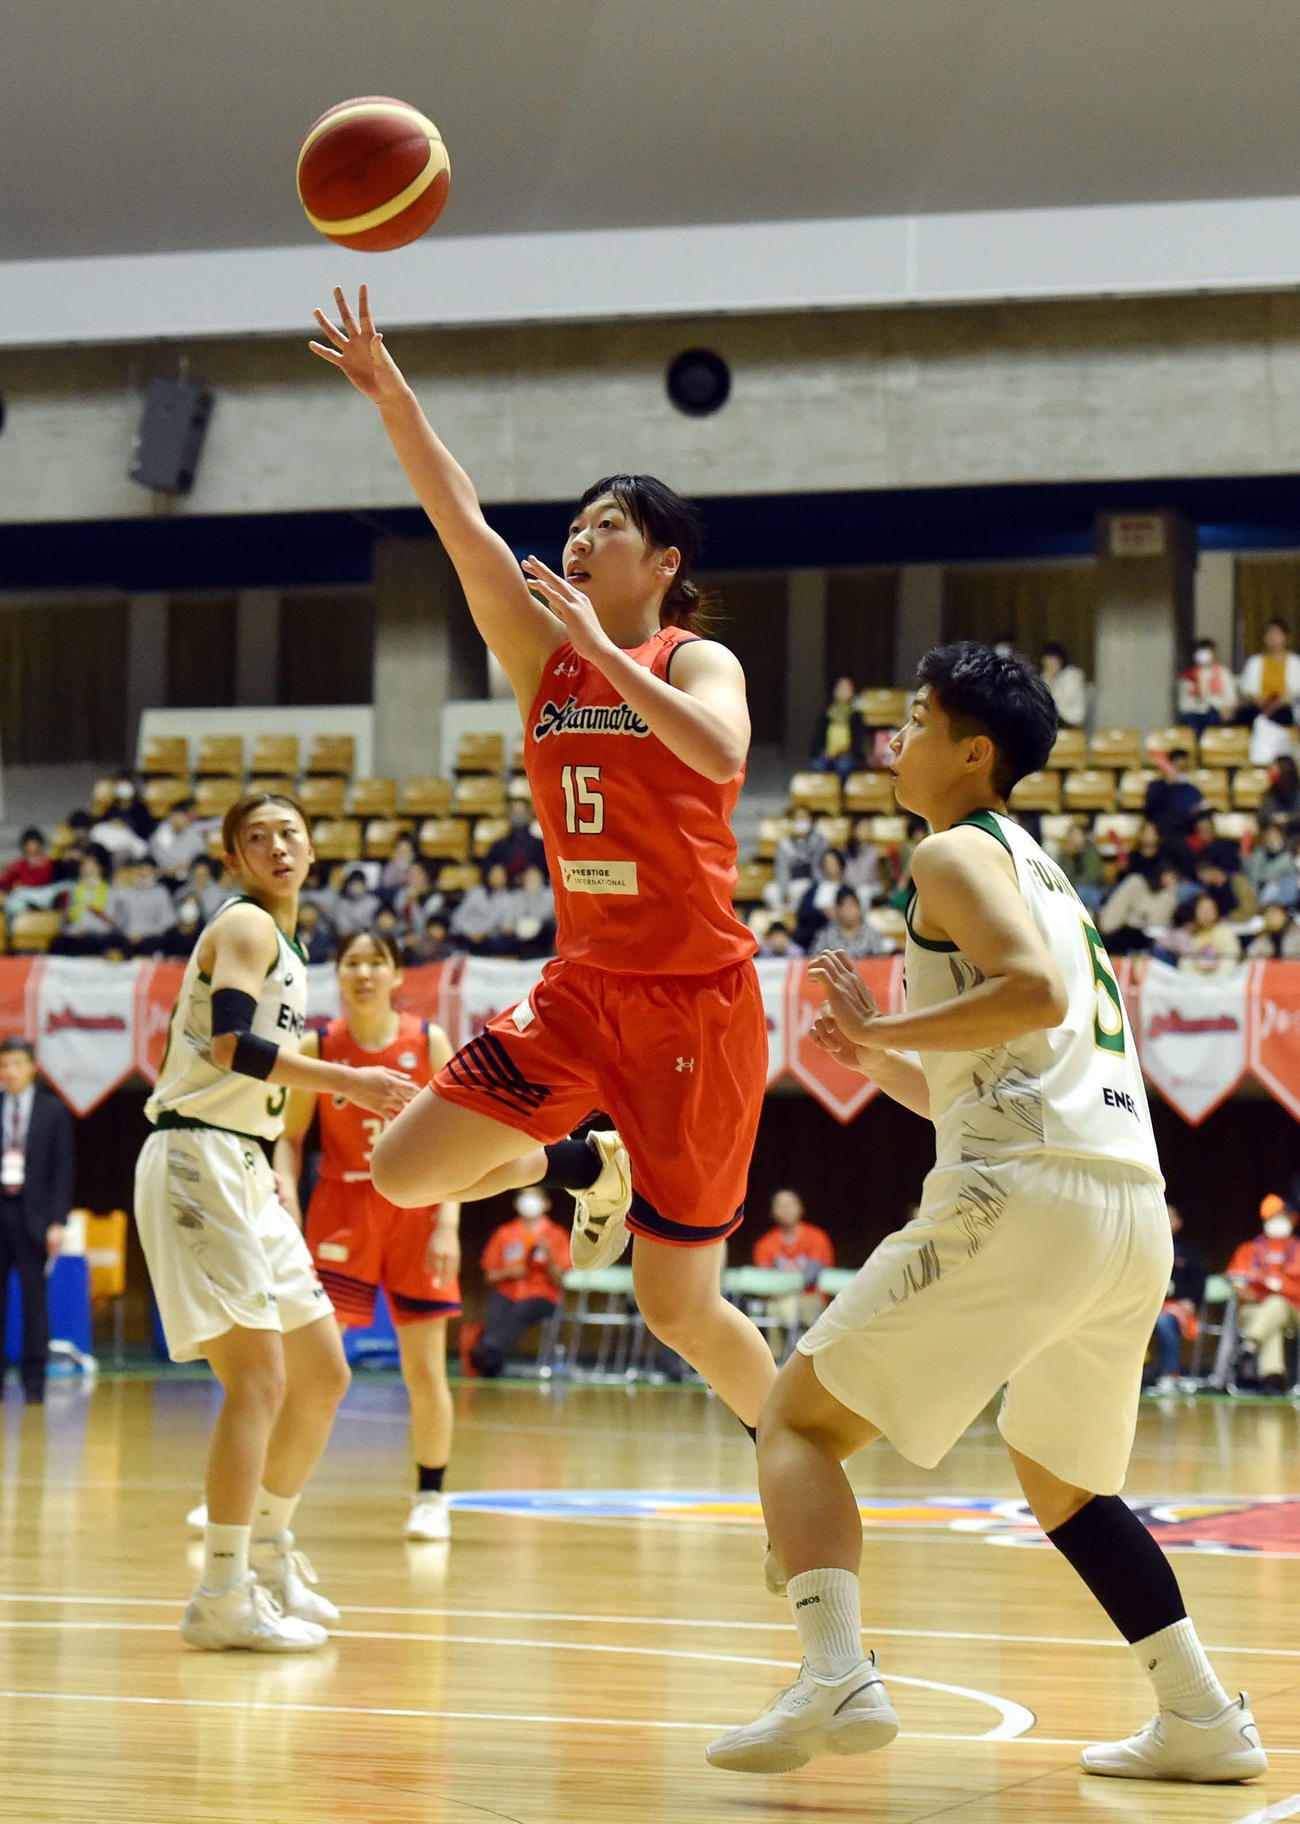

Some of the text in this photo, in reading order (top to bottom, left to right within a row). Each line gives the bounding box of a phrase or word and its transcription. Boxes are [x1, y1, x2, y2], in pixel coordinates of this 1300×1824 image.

[561, 765, 605, 835] 15
[571, 868, 610, 877] PRESTIGE
[574, 877, 627, 888] INTERNATIONAL
[1079, 914, 1126, 1059] 5
